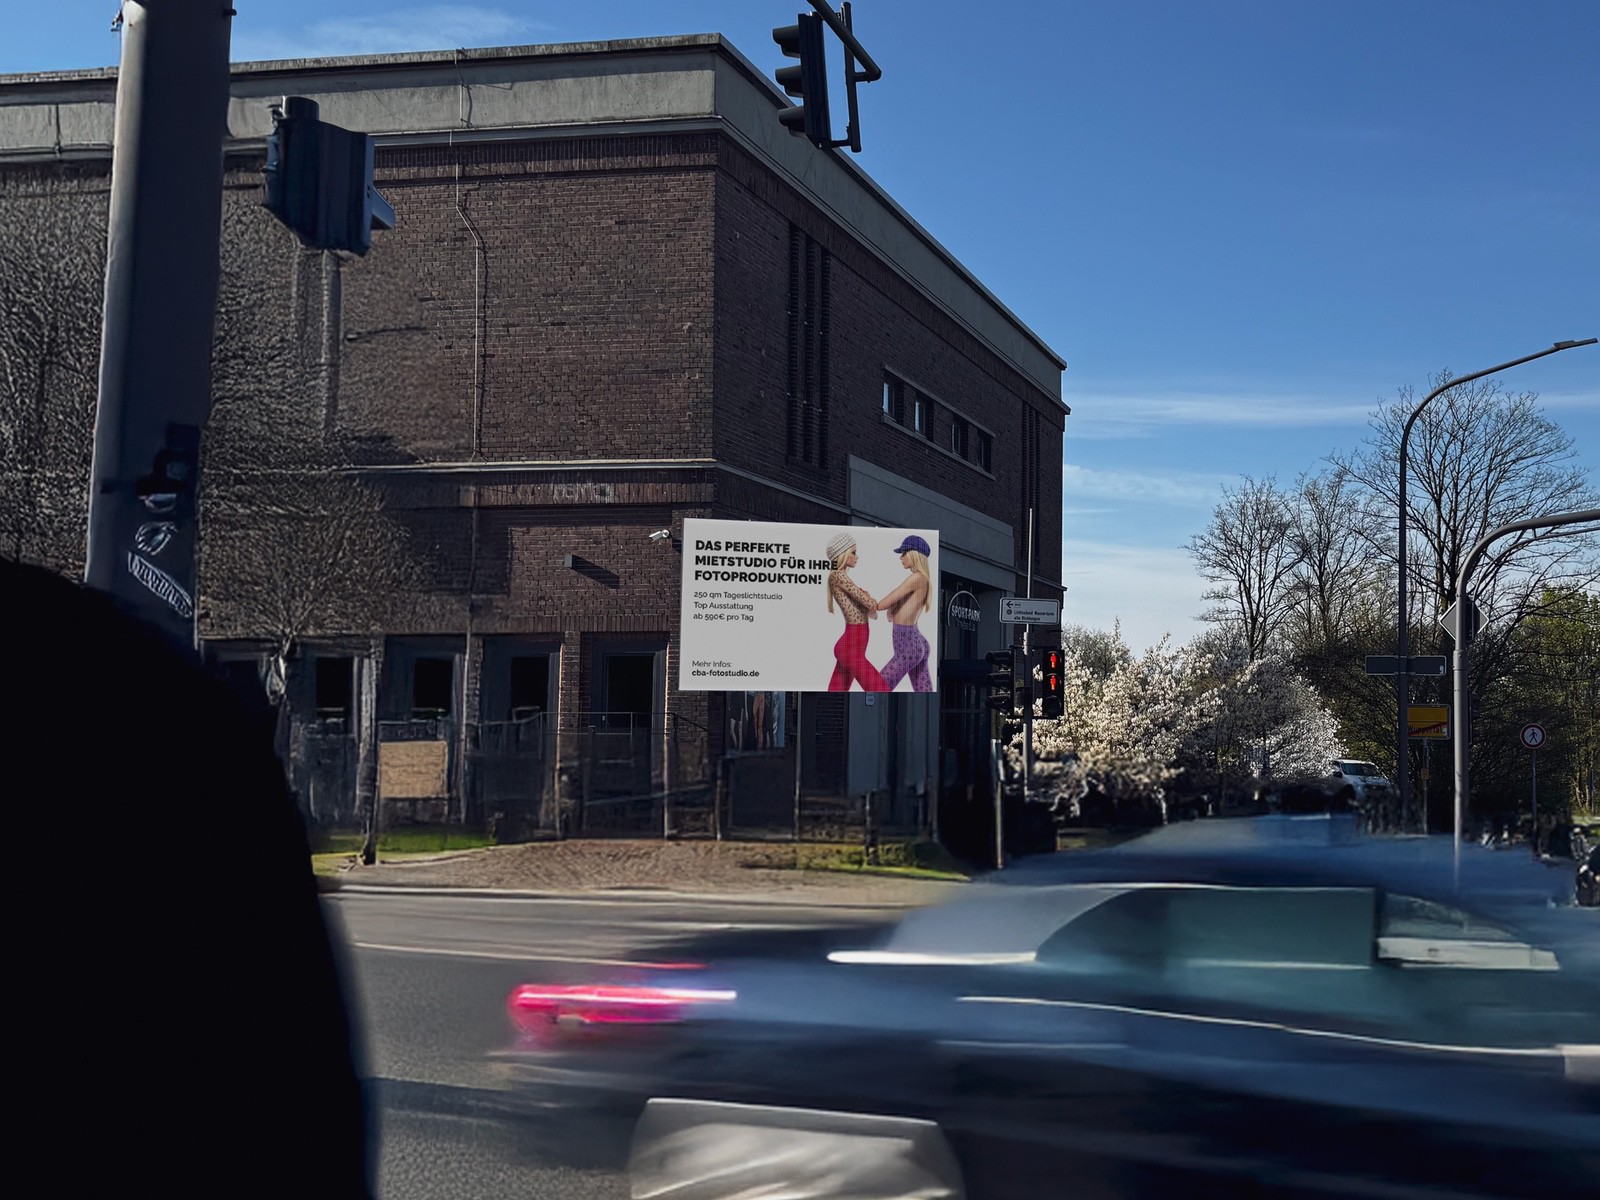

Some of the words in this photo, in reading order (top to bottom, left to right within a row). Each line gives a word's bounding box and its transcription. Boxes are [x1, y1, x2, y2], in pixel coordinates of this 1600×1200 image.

[695, 540, 722, 551] DAS
[725, 541, 790, 554] PERFEKTE
[695, 555, 777, 568] MIETSTUDIO
[780, 556, 806, 570] FÜR
[808, 559, 838, 570] IHRE
[694, 570, 822, 585] FOTOPRODUKTION!
[709, 592, 722, 600] qm
[723, 591, 783, 600] Tageslichtstudio
[694, 601, 708, 609] Top
[709, 602, 754, 611] Ausstattung
[693, 612, 703, 620] ab
[704, 613, 725, 621] 590€
[726, 614, 740, 622] pro
[741, 613, 754, 622] Tag
[691, 660, 712, 668] Mehr
[712, 660, 732, 668] Infos:
[691, 669, 760, 677] cba-fotostudio.de
